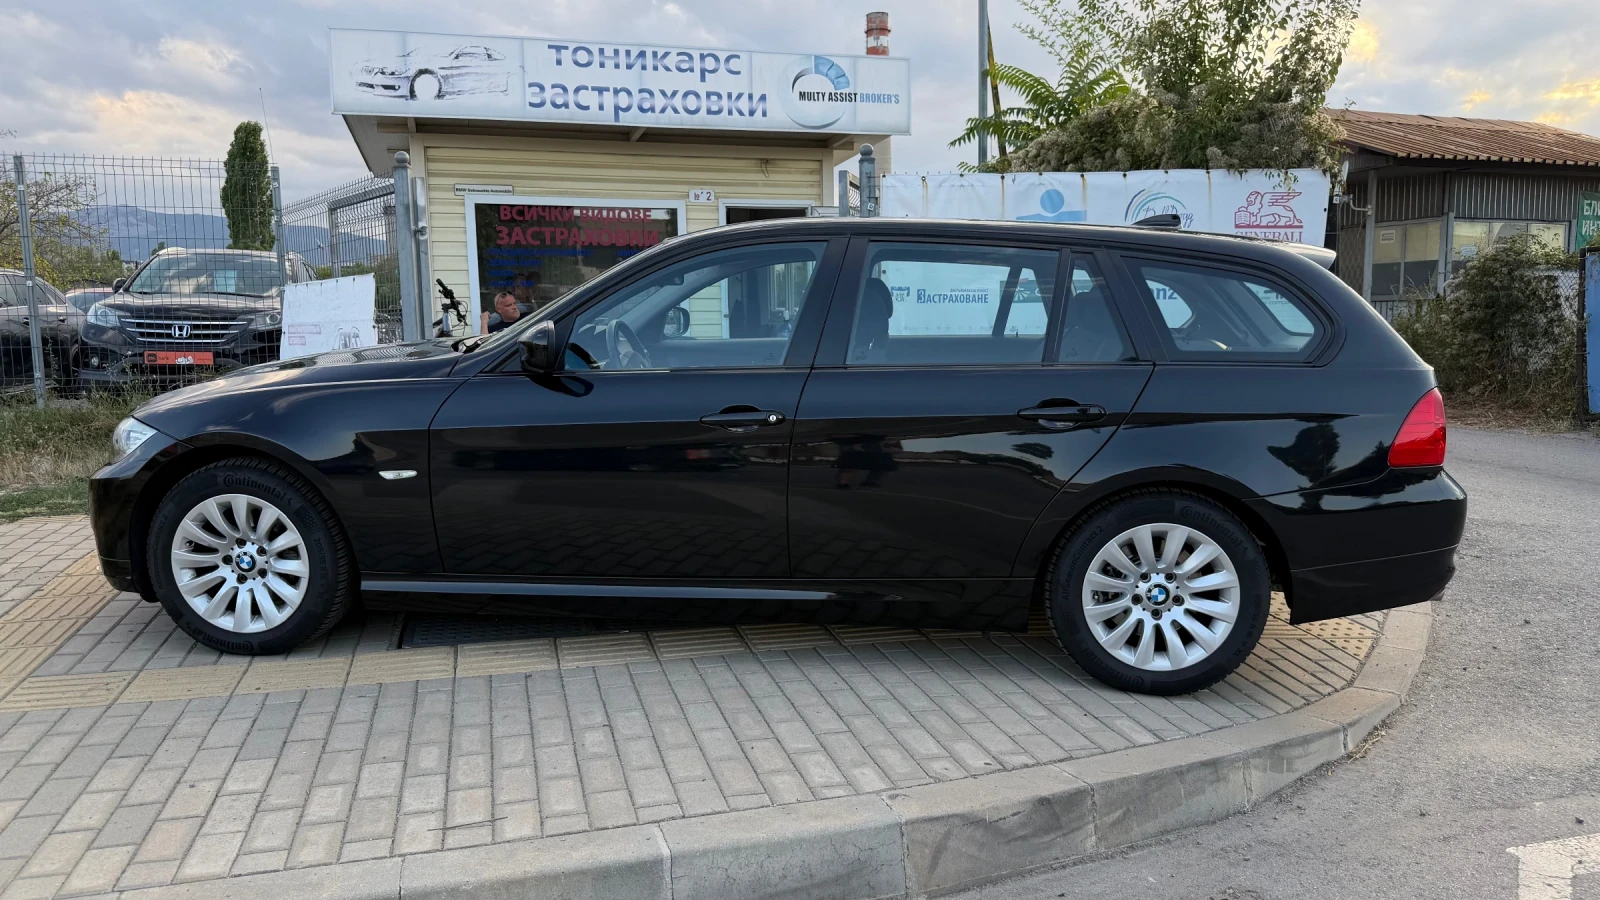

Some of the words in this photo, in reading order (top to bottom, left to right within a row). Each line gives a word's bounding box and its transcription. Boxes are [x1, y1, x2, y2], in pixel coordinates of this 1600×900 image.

[547, 43, 742, 83] тоникарс
[527, 82, 768, 122] застраховки
[798, 90, 826, 103] MULTY
[828, 91, 857, 103] ASSIST
[859, 92, 900, 105] BROKER'S
[706, 191, 712, 201] 2
[500, 205, 575, 222] ВСИЧКИ
[580, 208, 652, 225] ВИДОВЕ
[496, 225, 660, 247] ЗАСТРАХОВКИ
[1235, 231, 1303, 243] NERALI
[916, 288, 989, 304] ЗАСТРАХОВАНЕ
[223, 473, 287, 502] Continental
[1180, 506, 1244, 547] Continental
[314, 537, 327, 565] 205/55
[1063, 532, 1099, 601] AllSeasonContact
[1096, 525, 1104, 533] 2
[191, 627, 254, 653] Continental
